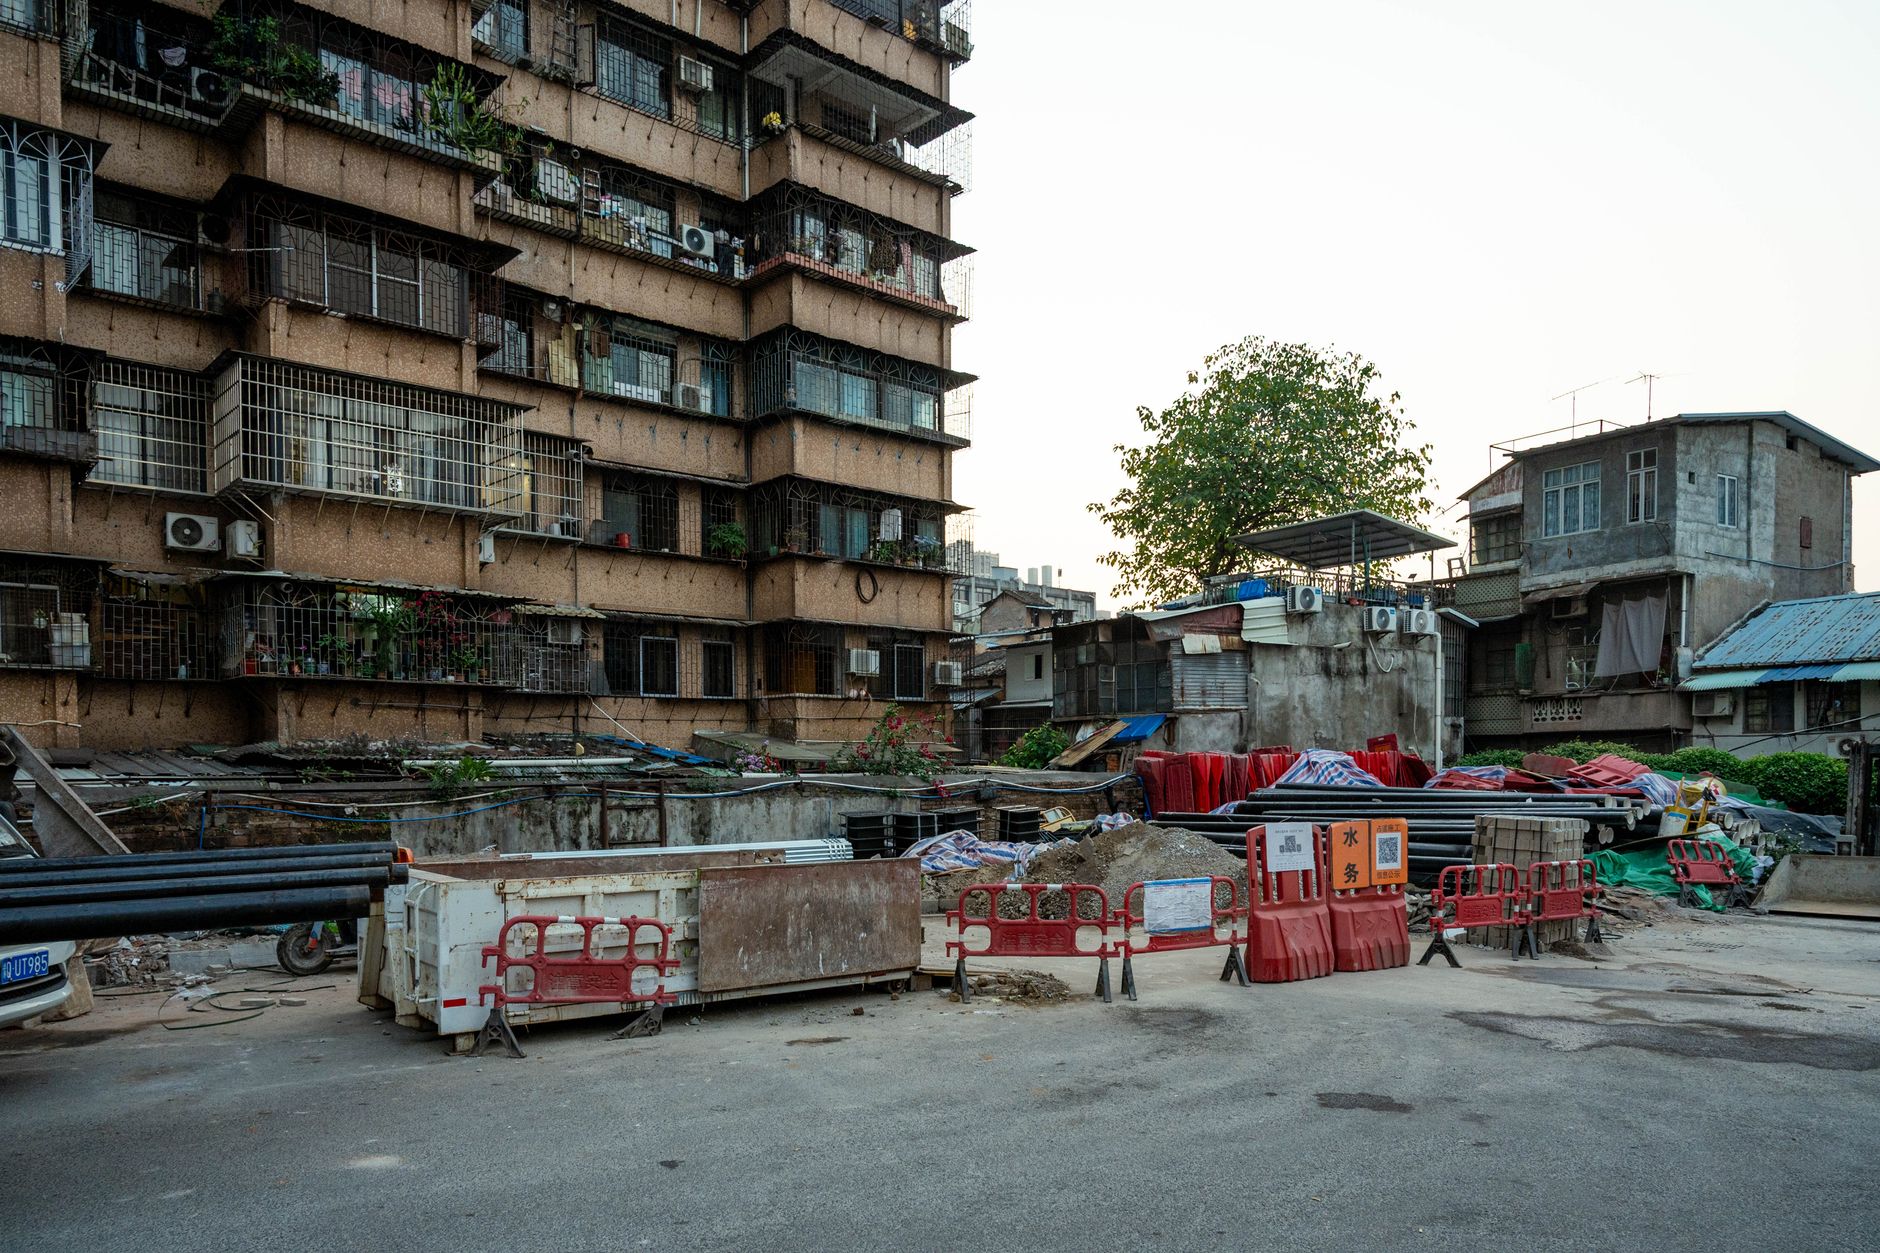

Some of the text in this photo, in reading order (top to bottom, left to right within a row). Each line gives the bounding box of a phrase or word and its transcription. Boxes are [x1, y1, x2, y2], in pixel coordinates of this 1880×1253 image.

[1343, 826, 1359, 884] 水务
[547, 971, 620, 991] 注意安全
